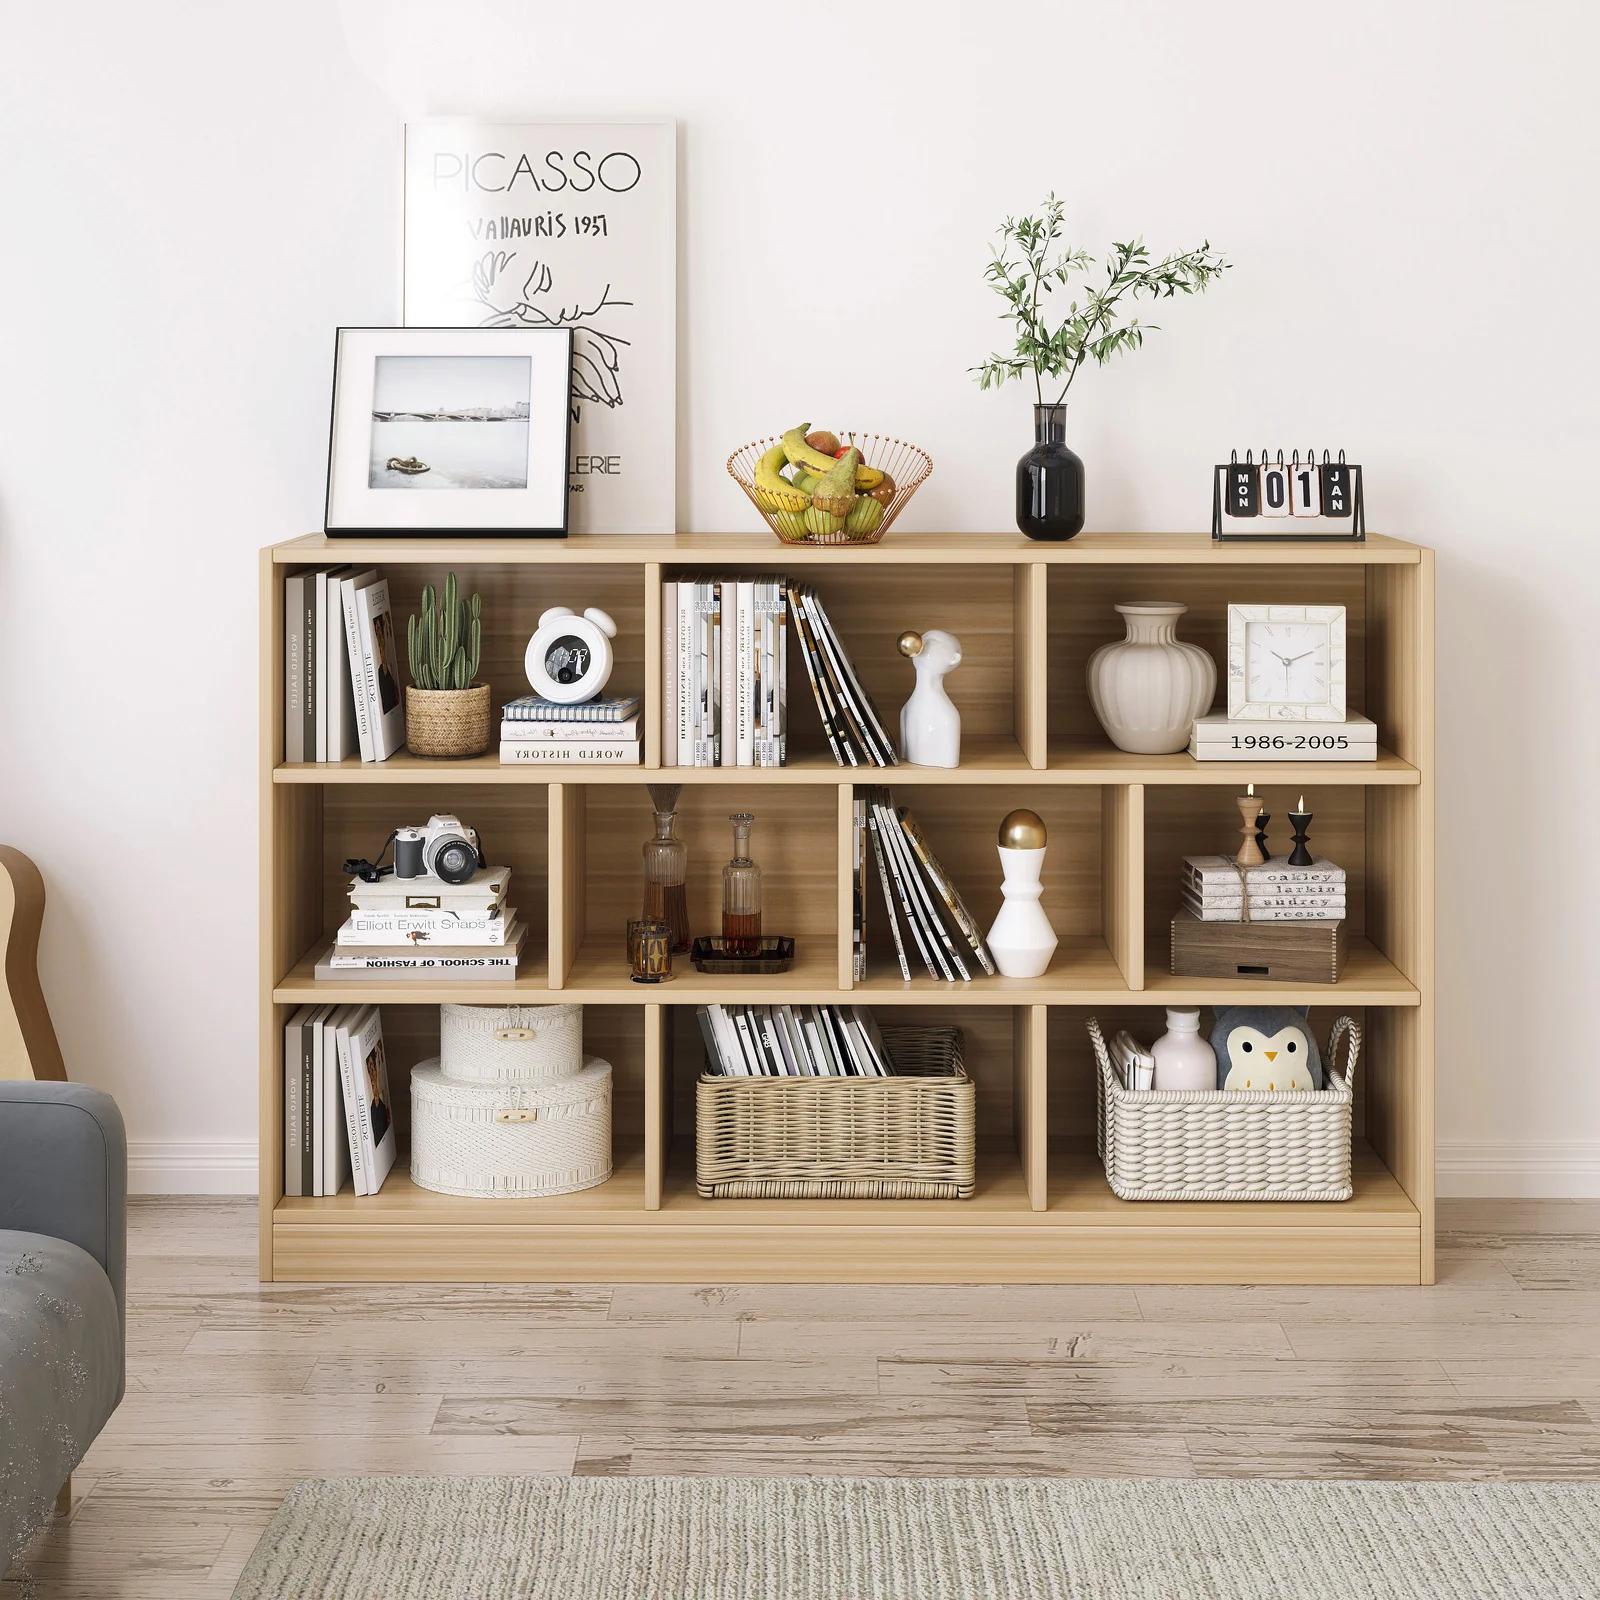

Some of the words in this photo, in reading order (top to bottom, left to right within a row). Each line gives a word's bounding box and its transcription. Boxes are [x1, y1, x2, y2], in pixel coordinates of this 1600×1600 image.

[434, 151, 641, 192] PICASSO
[575, 214, 607, 236] 1957
[1238, 474, 1248, 507] MON
[1331, 472, 1342, 510] JAN
[1231, 736, 1348, 749] 1986-2005
[1268, 873, 1332, 882] oakley
[1264, 898, 1330, 906] audrey
[356, 920, 392, 930] Elliott
[398, 920, 436, 930] Erwitt
[441, 919, 486, 932] Snaps
